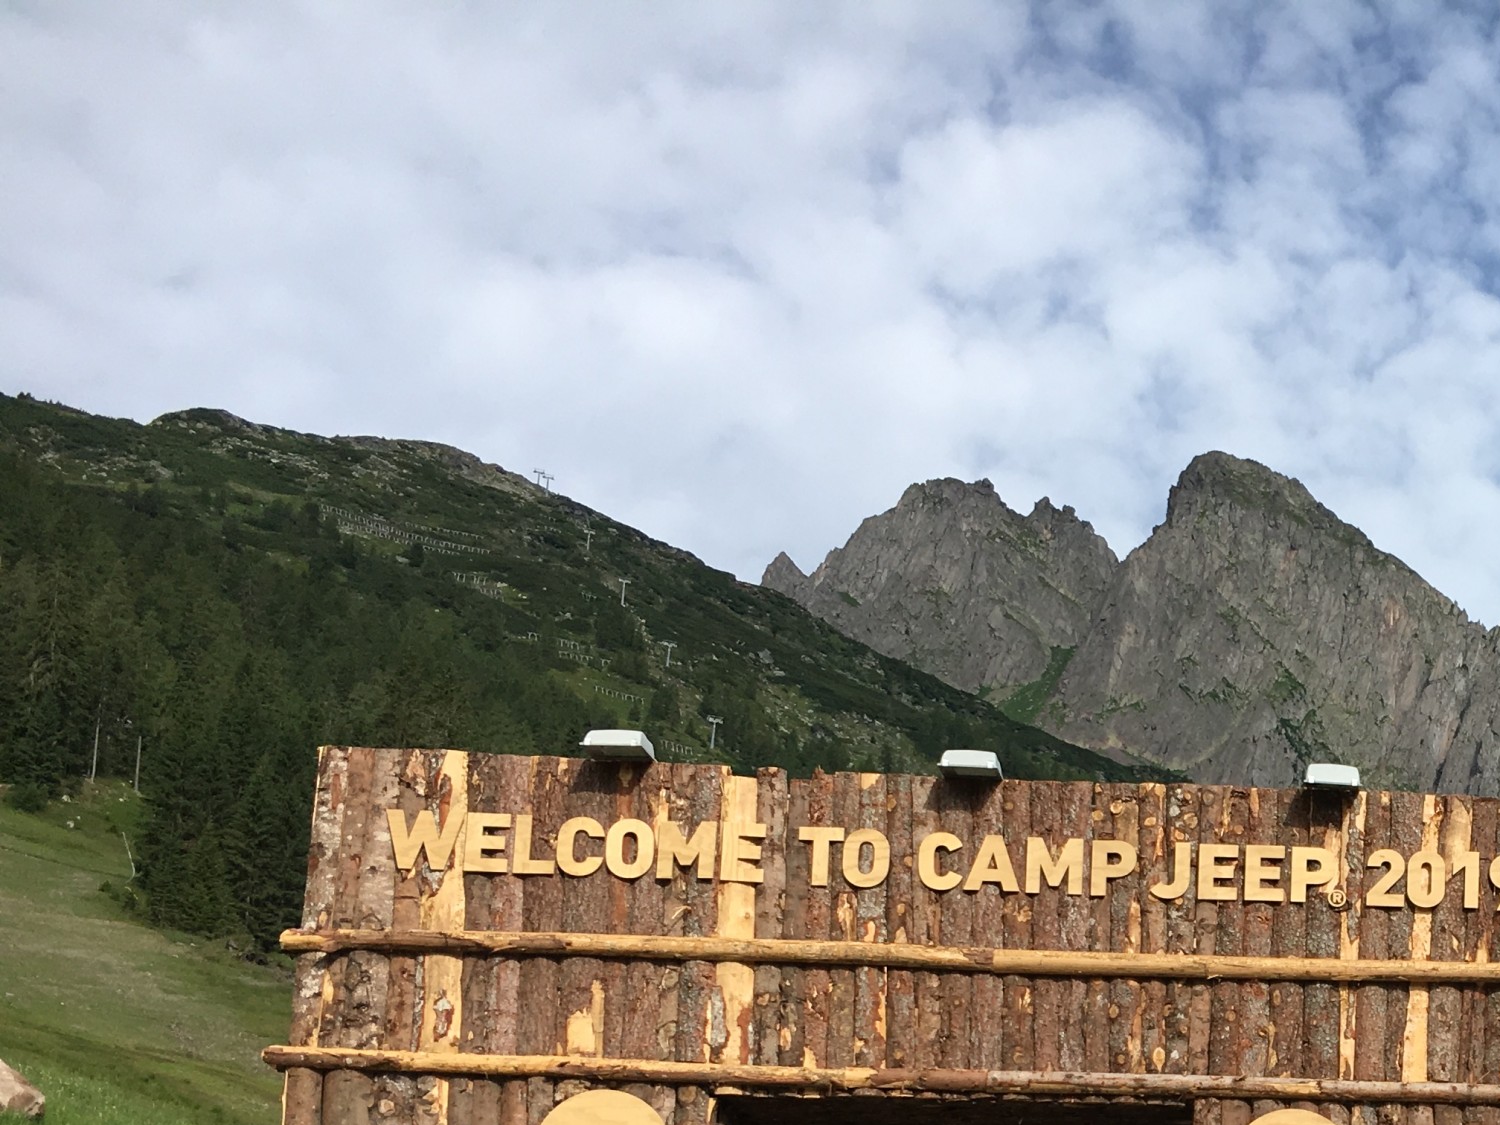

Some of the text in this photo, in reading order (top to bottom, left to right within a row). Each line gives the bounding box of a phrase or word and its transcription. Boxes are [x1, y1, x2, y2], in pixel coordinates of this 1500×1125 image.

[386, 808, 767, 883] WELCOME
[798, 826, 891, 888] TO
[917, 831, 1138, 898] CAMP
